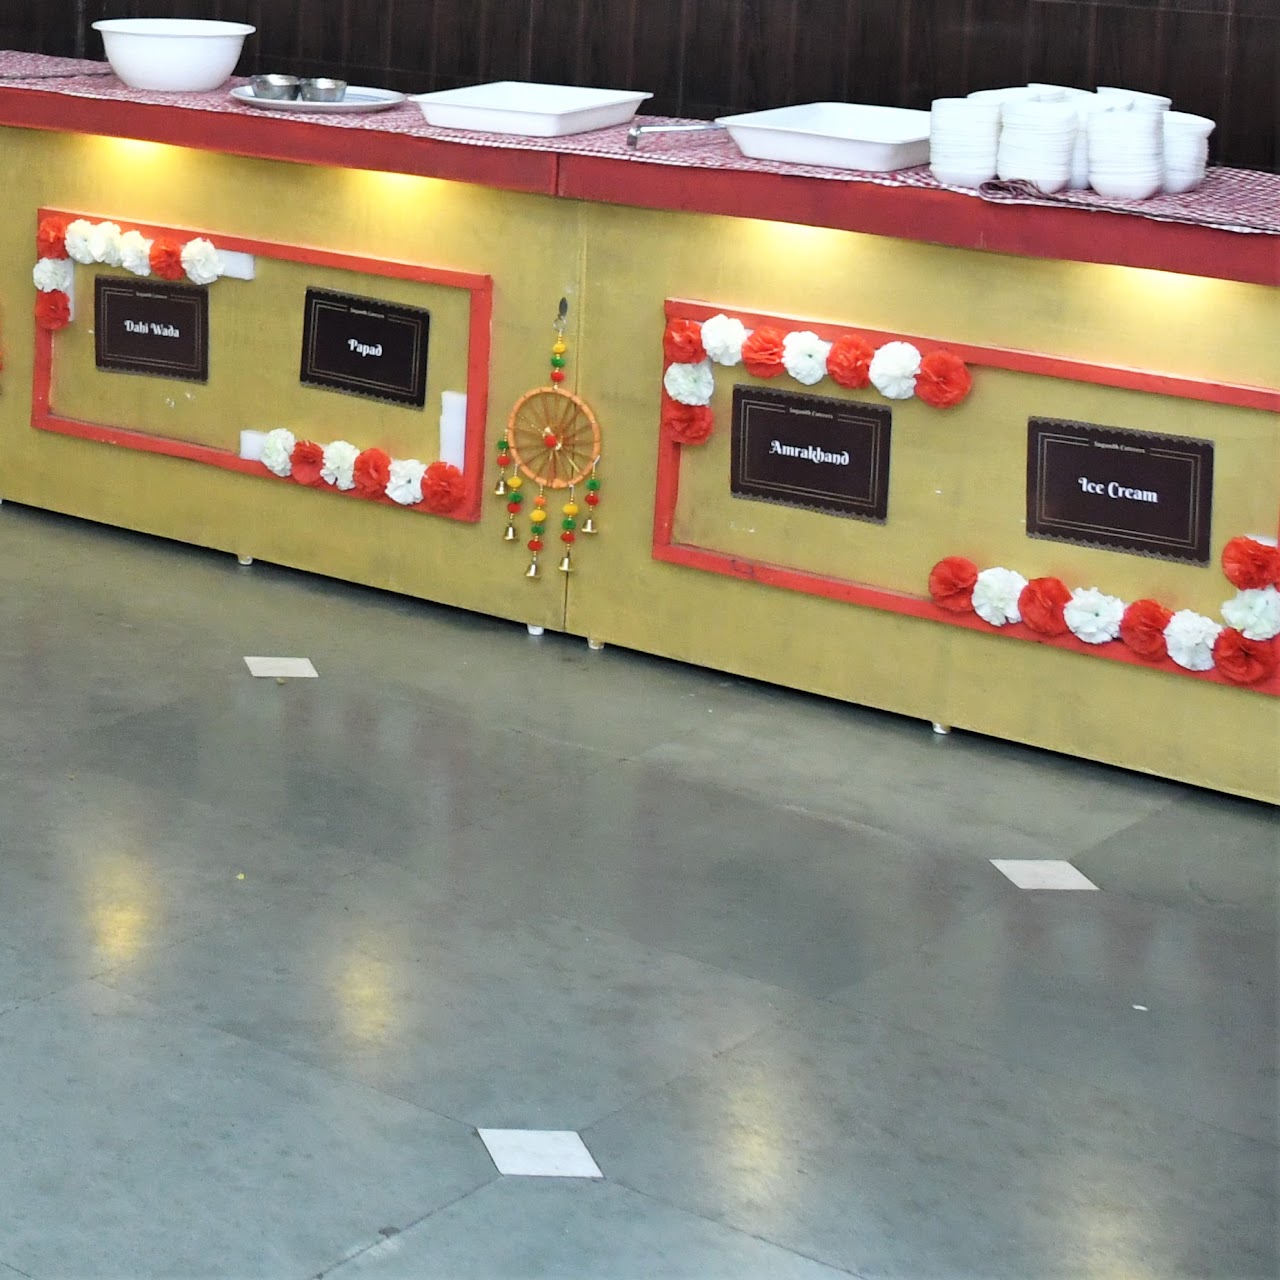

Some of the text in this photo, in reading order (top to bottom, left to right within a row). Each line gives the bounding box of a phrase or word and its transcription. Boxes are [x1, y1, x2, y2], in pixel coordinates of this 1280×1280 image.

[124, 320, 180, 338] Dahi Wada
[348, 338, 383, 357] Papad
[769, 439, 850, 466] Amrakhand
[1077, 476, 1158, 504] Ice Cream
